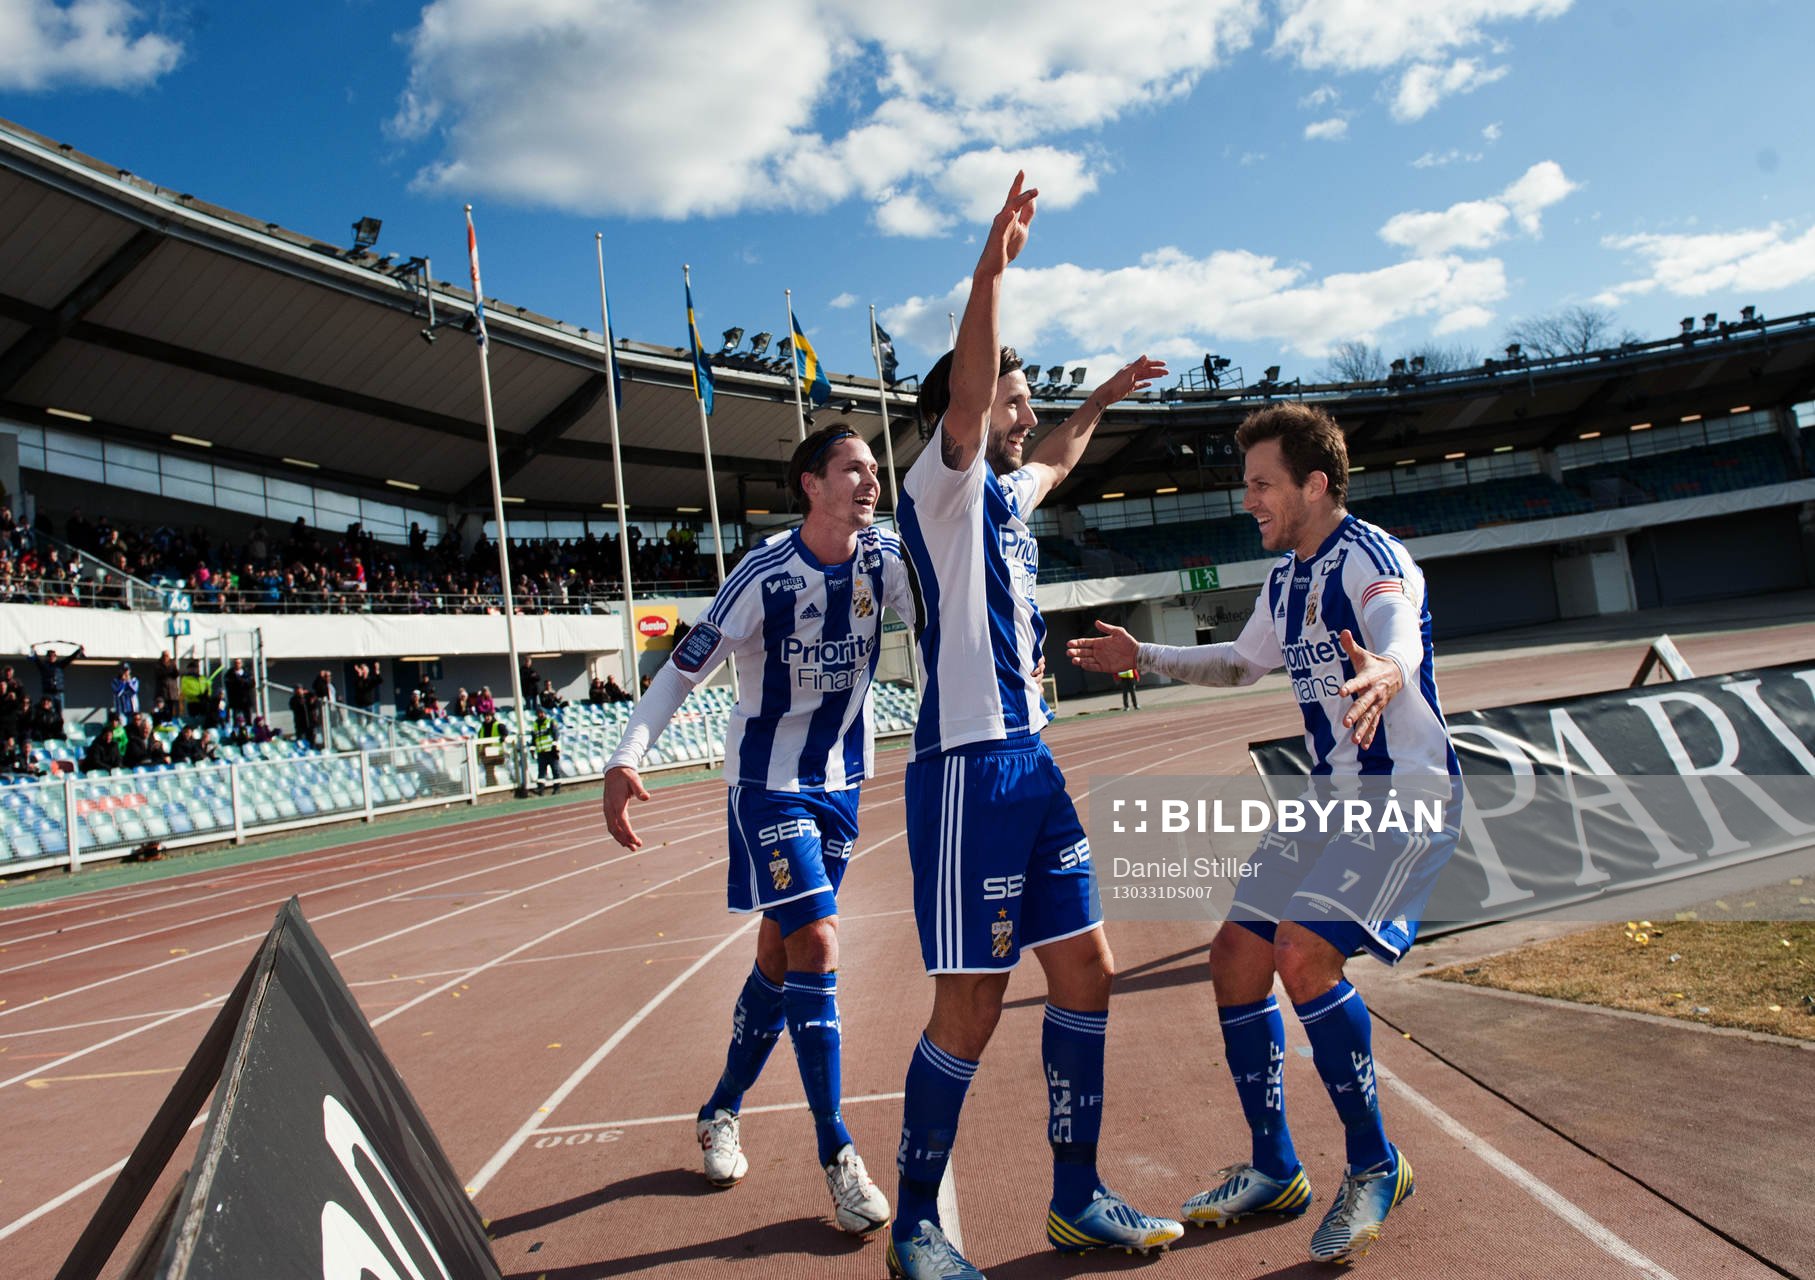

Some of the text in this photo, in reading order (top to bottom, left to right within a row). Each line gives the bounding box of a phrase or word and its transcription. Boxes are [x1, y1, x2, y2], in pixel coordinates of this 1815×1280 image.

[983, 874, 1026, 900] SE
[1337, 868, 1361, 893] 7
[1265, 1041, 1284, 1111] SKF
[534, 1129, 625, 1149] 300
